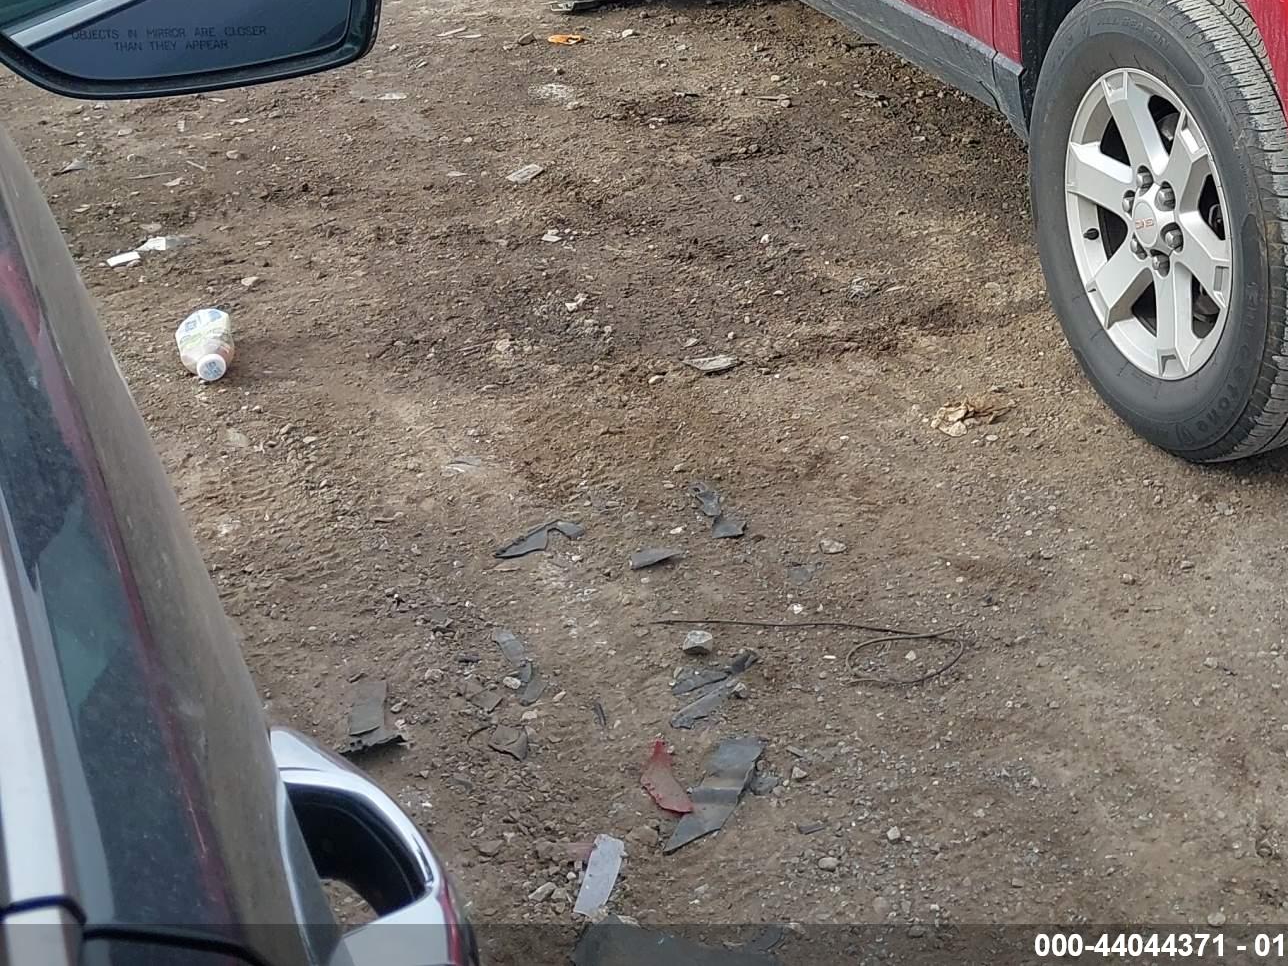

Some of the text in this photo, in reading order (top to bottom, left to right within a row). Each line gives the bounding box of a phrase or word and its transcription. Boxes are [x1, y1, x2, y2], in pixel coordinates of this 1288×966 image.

[71, 25, 267, 41] OBJECTS IN MIRROR ARE CLOSER
[114, 40, 228, 52] THAN THEY APPEAR
